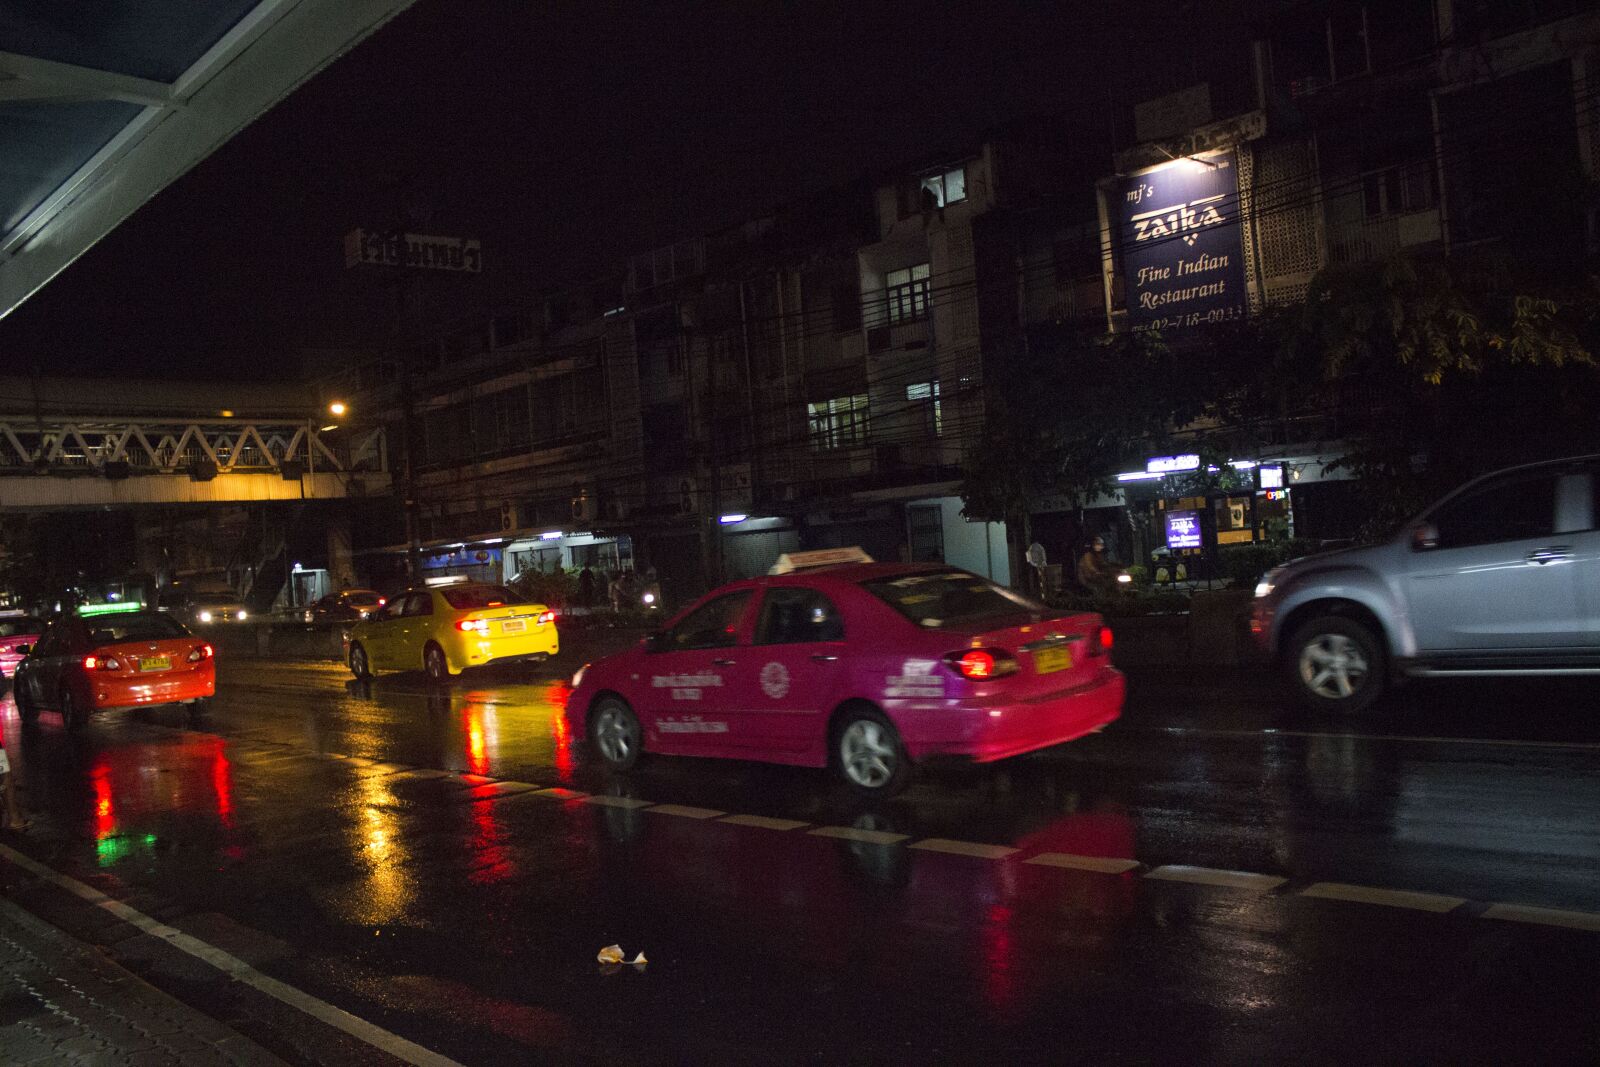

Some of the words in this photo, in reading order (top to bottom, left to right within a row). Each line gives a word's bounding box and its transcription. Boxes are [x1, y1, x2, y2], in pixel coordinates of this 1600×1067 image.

[1126, 184, 1154, 205] mj's
[1137, 266, 1171, 287] Fine
[1176, 252, 1230, 277] Indian
[1139, 279, 1226, 310] Restaurant
